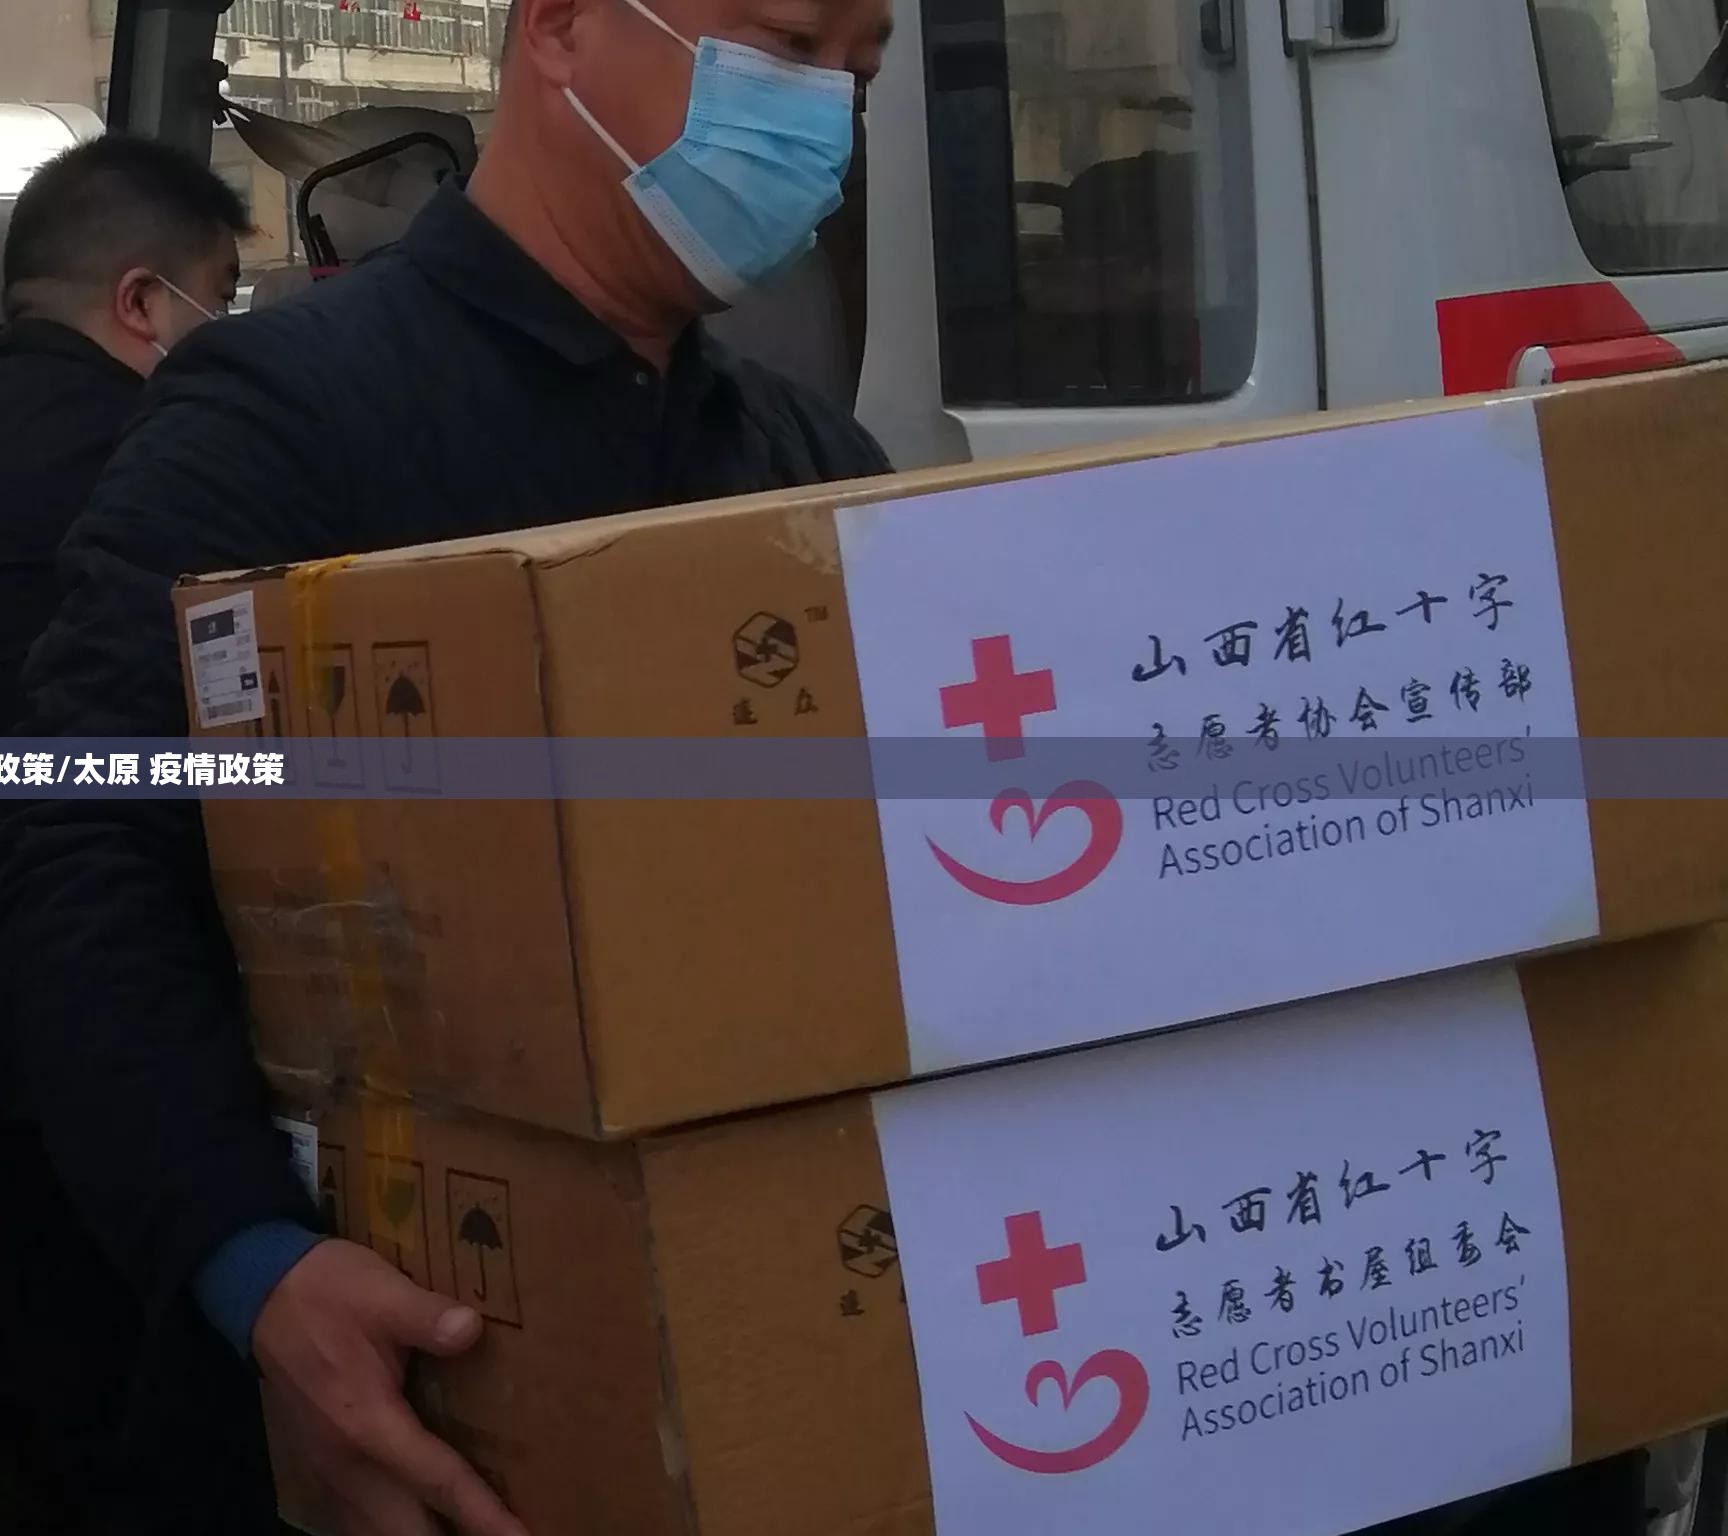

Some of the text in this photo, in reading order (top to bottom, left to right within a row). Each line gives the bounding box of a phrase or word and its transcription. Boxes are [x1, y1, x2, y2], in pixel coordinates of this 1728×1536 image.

[1131, 571, 1515, 684] 山西省红十字
[1145, 657, 1534, 774] 志愿者协会宣传部
[1152, 727, 1533, 831] Red Cross Volunteers'
[1158, 773, 1535, 880] Association of Shanxi
[1154, 1128, 1508, 1254] 山西省红十字
[1170, 1211, 1531, 1339] 志愿者书屋组委会
[1177, 1275, 1527, 1395] Red Cross Volunteers'
[1181, 1320, 1526, 1441] Association of Shanxi
